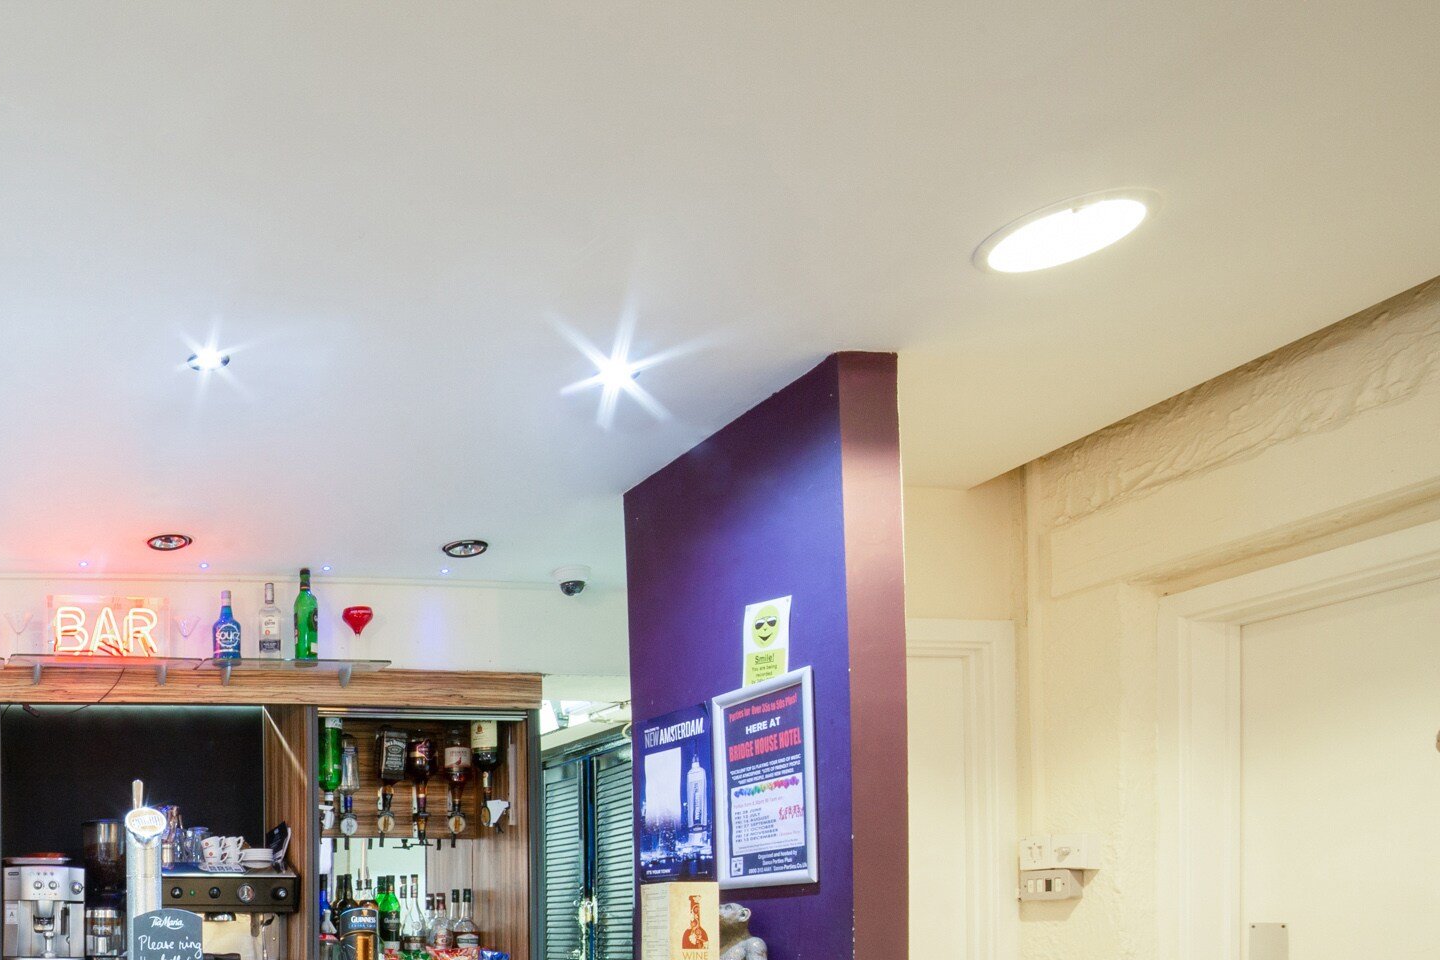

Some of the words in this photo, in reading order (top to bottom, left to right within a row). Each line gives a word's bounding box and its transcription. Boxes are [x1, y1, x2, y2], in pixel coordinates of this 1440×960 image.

[55, 606, 158, 653] BAR
[755, 653, 774, 663] Smile!
[745, 720, 768, 734] HERE
[769, 716, 780, 728] AT
[644, 730, 659, 749] NEW
[729, 740, 754, 762] BRIDGE
[754, 733, 778, 755] HOUSE
[779, 727, 801, 749] HOTEL
[751, 819, 776, 827] SEPTEMBER
[162, 916, 184, 928] Maria
[138, 935, 174, 951] Please
[179, 936, 202, 959] ring
[682, 952, 708, 960] WINE
